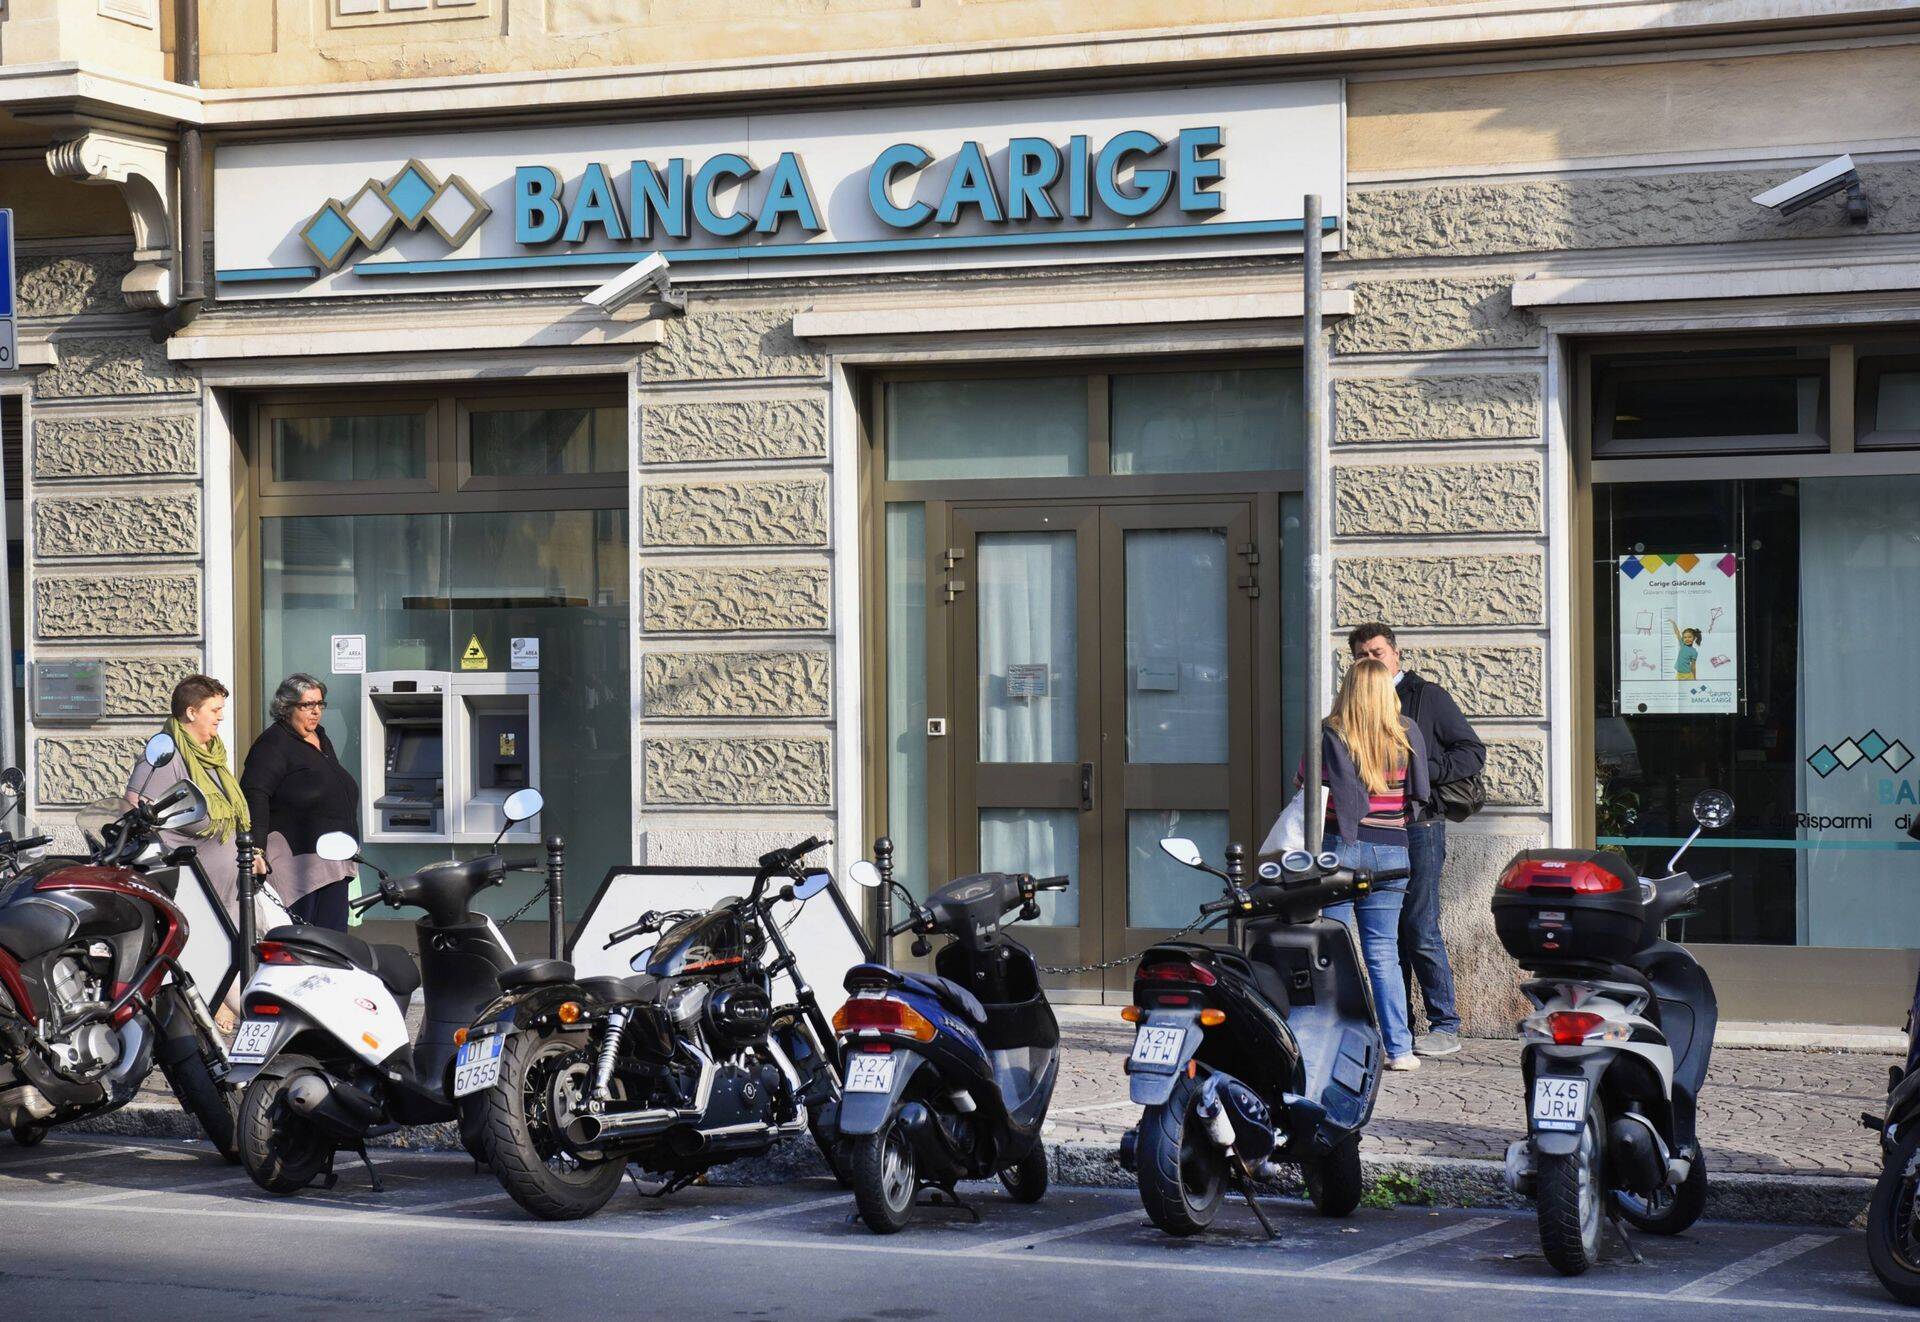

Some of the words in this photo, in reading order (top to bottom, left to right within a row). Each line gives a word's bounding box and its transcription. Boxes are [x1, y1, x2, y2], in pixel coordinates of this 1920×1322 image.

[515, 151, 826, 246] BANCA
[868, 126, 1225, 229] CARIGE
[1878, 778, 1920, 806] BA
[1796, 813, 1872, 832] Risparmi
[1894, 814, 1911, 829] di
[242, 1023, 270, 1037] X82
[1143, 1030, 1177, 1045] X2H
[236, 1038, 260, 1052] L9L
[468, 1040, 485, 1062] DT
[1139, 1045, 1172, 1060] WTW
[857, 1058, 890, 1072] X27
[457, 1061, 497, 1090] 67355
[852, 1074, 885, 1088] FFN
[1541, 1081, 1578, 1099] X46
[1540, 1100, 1577, 1118] JRW
